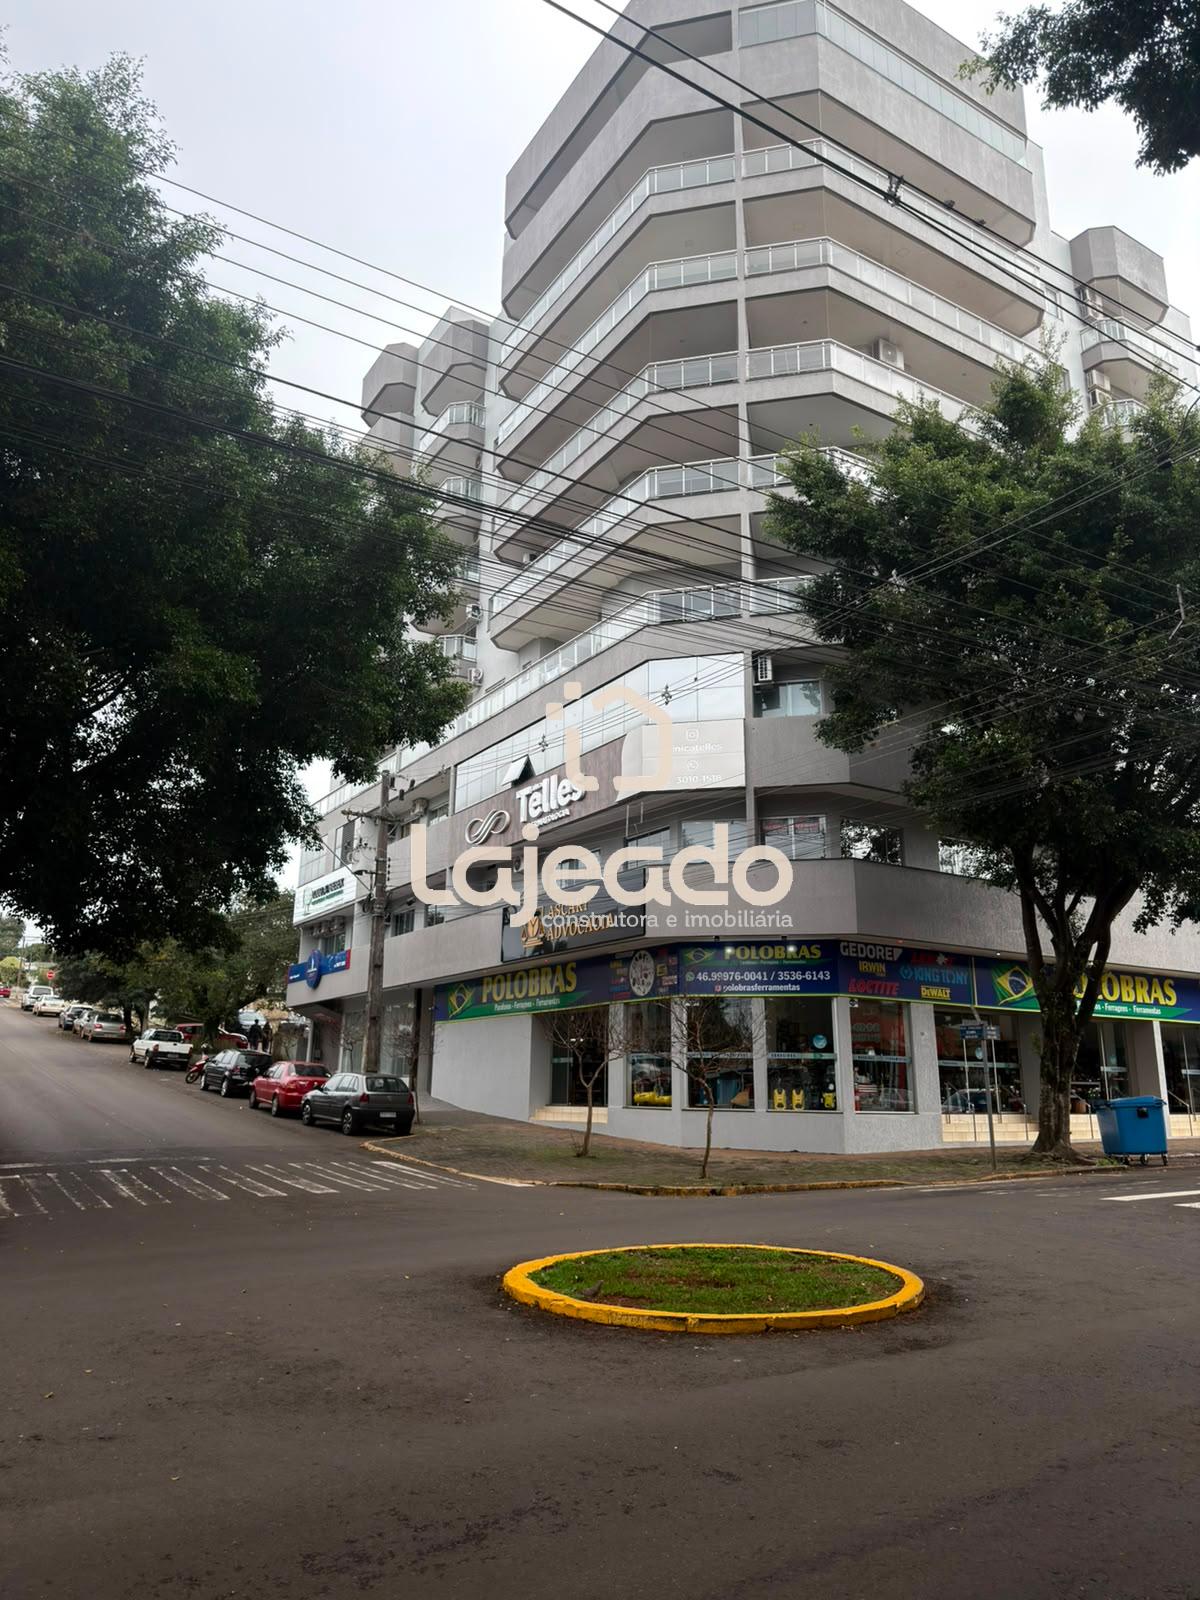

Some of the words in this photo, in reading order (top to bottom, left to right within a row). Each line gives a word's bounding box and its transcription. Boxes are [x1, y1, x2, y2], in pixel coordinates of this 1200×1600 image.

[723, 944, 821, 960] POLOBRAS
[840, 942, 898, 961] GEDORE
[481, 962, 577, 1004] POLOBRAS
[778, 971, 831, 981] 3536-6143
